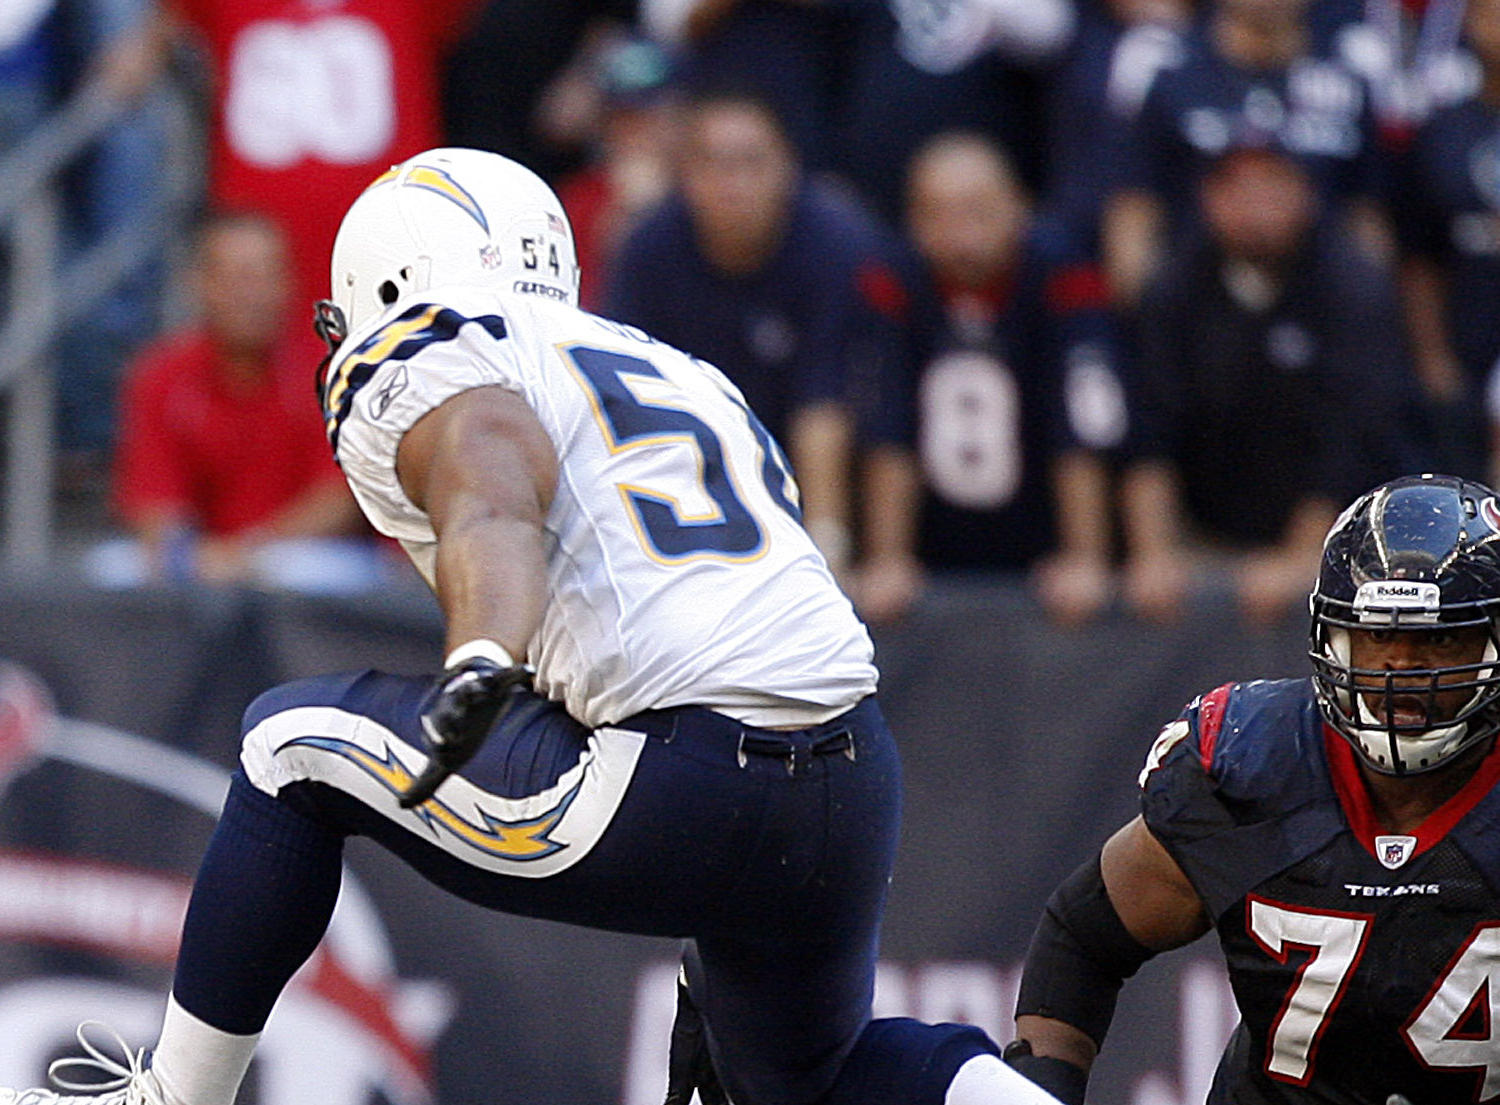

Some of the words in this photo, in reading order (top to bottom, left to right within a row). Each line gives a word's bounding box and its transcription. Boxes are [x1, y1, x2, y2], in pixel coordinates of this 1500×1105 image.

[521, 236, 560, 277] 54
[918, 350, 1023, 508] 8
[1344, 883, 1441, 898] TEXANS
[1246, 892, 1500, 1105] 74
